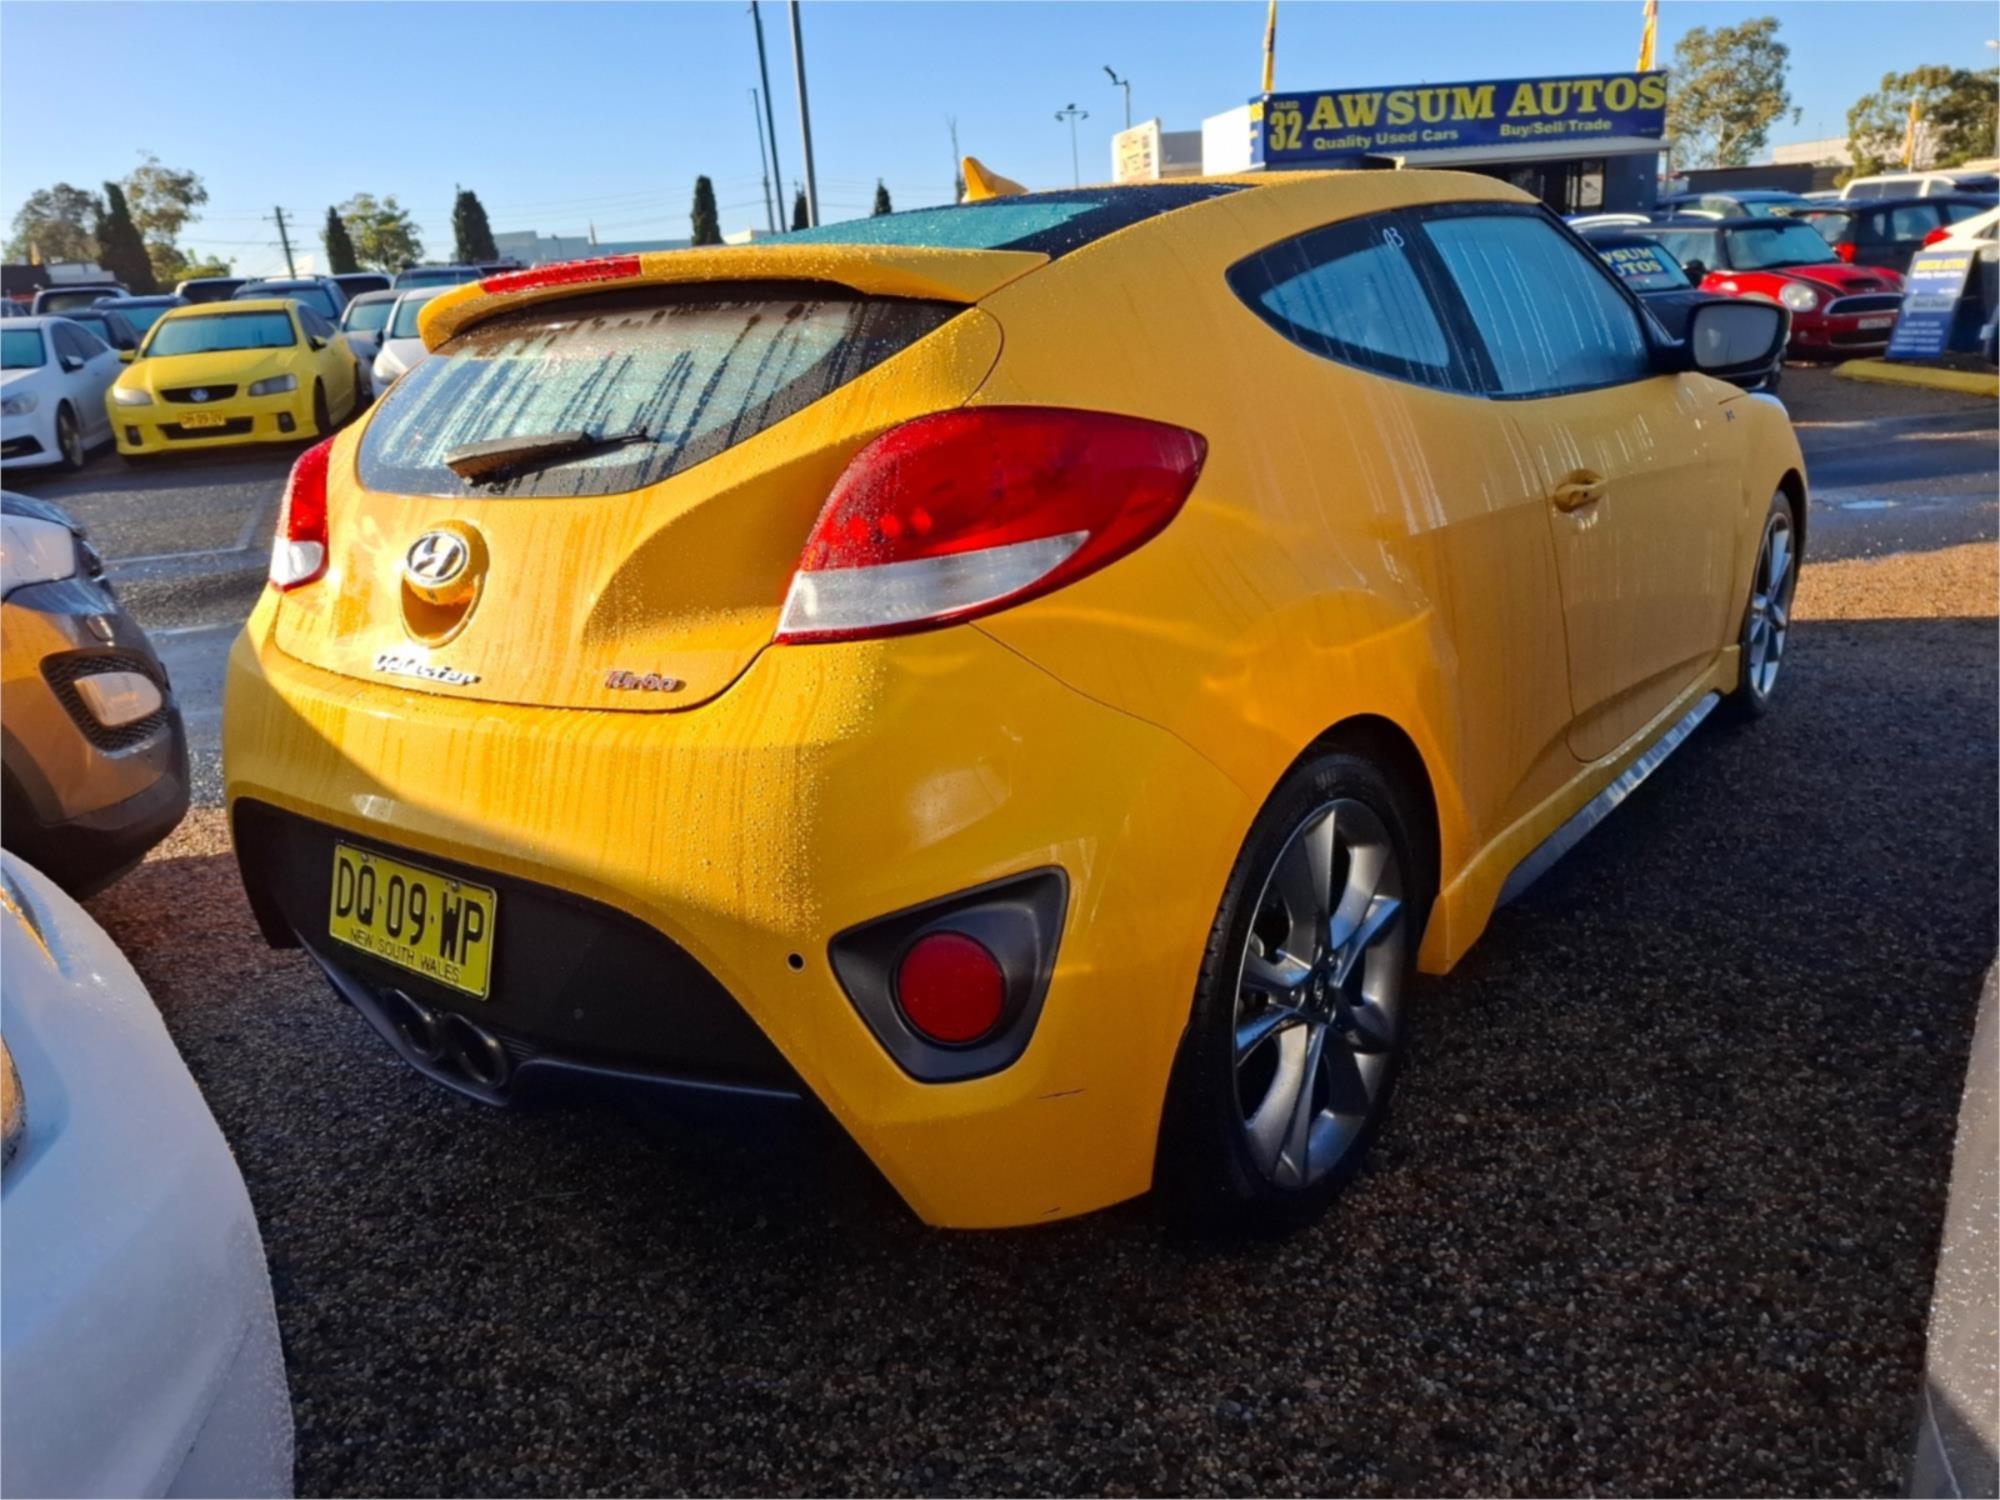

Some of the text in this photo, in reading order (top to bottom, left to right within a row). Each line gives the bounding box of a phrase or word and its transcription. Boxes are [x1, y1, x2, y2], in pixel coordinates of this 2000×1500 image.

[1272, 100, 1298, 110] YARD
[1306, 84, 1496, 131] AWSUM
[1506, 75, 1667, 117] AUTOS
[1269, 110, 1302, 151] 32
[1313, 128, 1459, 150] Quality Used Cars
[1616, 260, 1664, 277] UTOS
[350, 927, 461, 982] NEW SOUTH WALES
